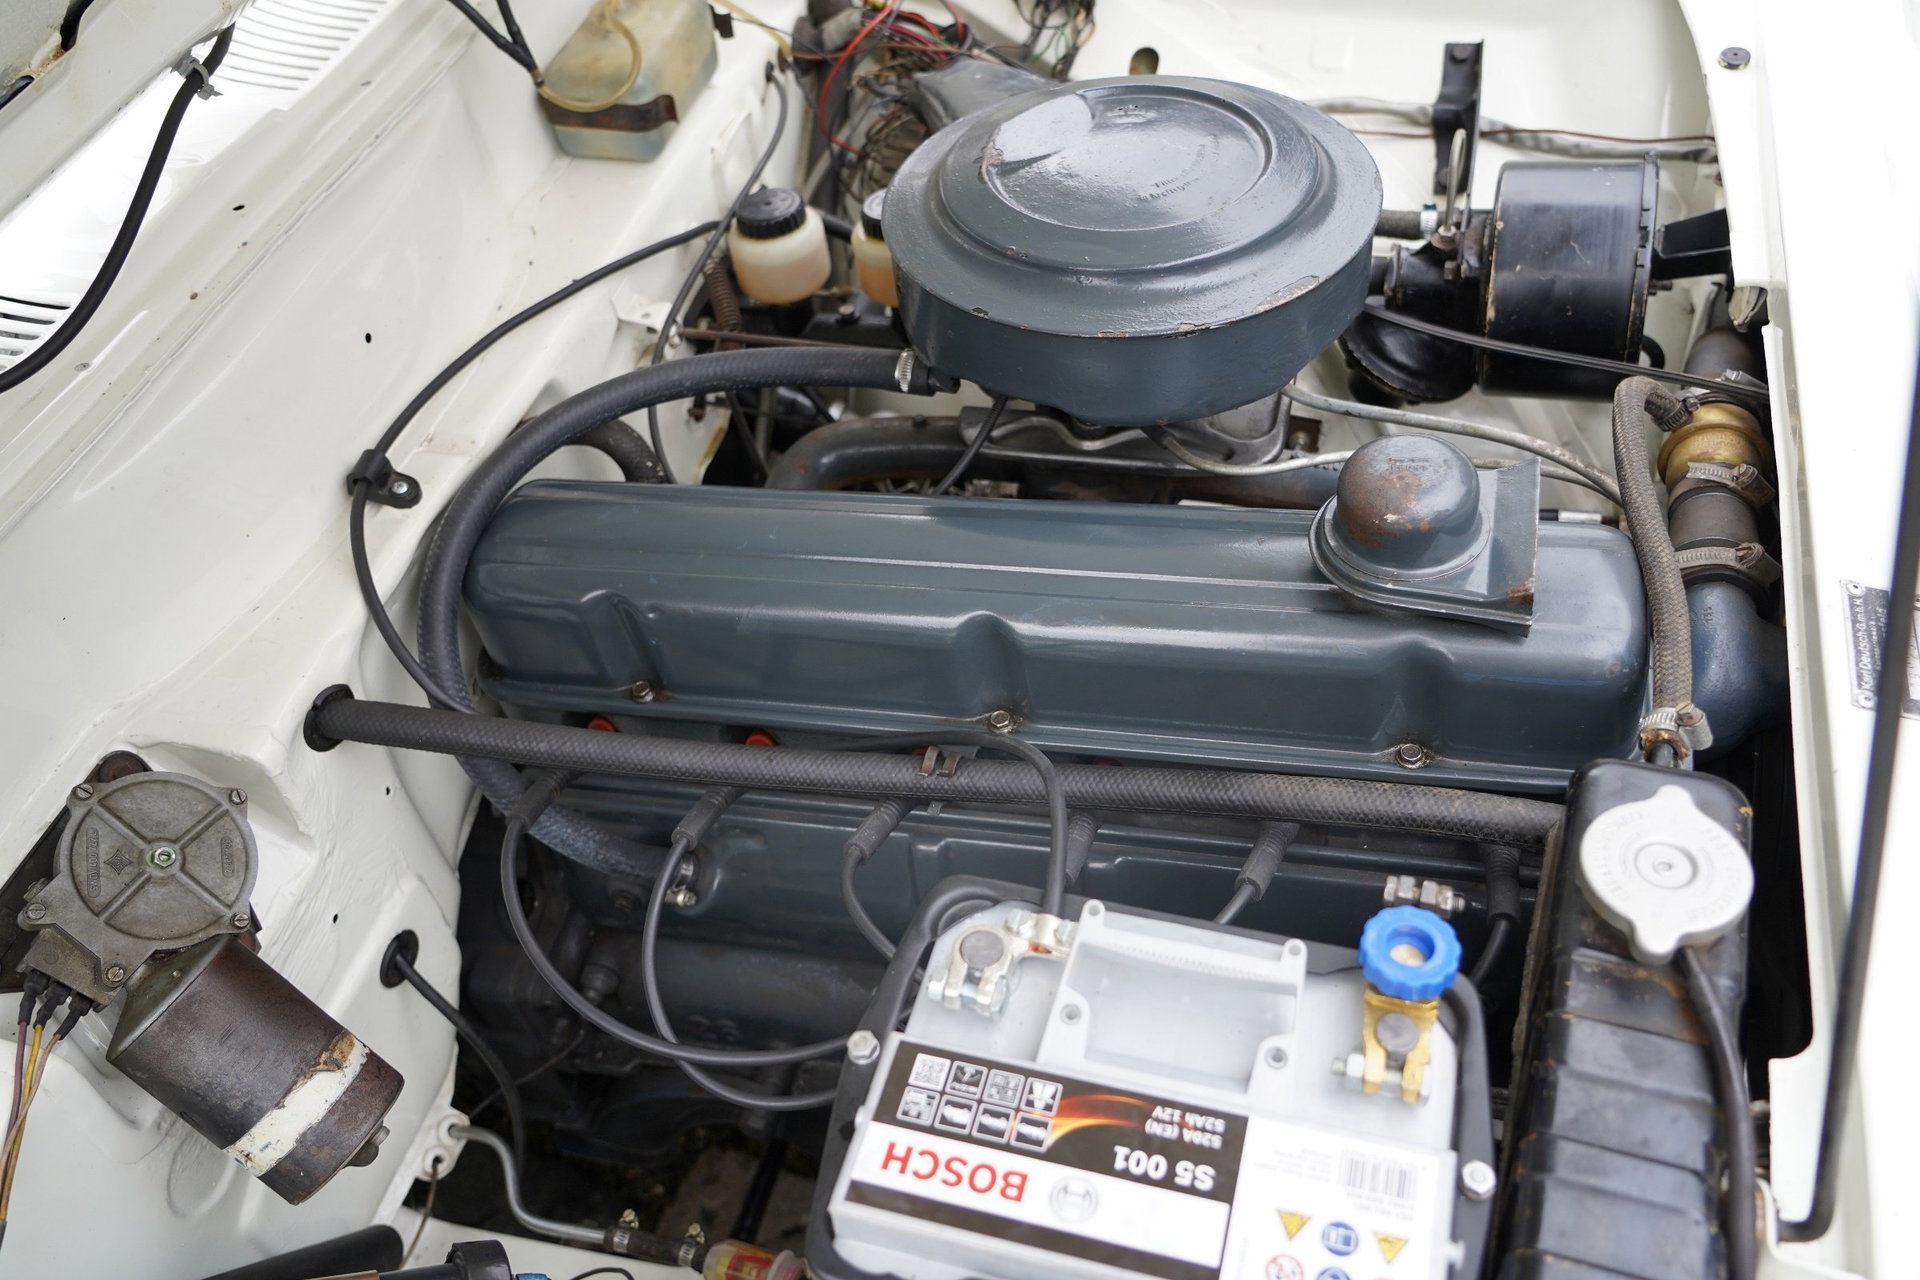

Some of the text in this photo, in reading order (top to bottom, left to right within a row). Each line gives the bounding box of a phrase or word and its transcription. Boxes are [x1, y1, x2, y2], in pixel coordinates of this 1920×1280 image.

[1856, 631, 1872, 670] Deutsch
[1860, 671, 1873, 691] Karl
[1144, 1118, 1225, 1150] 520A (EN)
[1150, 1104, 1227, 1132] 52Ah 12V
[880, 1141, 1029, 1203] BOSCH
[1112, 1144, 1169, 1182] 001
[1172, 1159, 1218, 1193] S5
